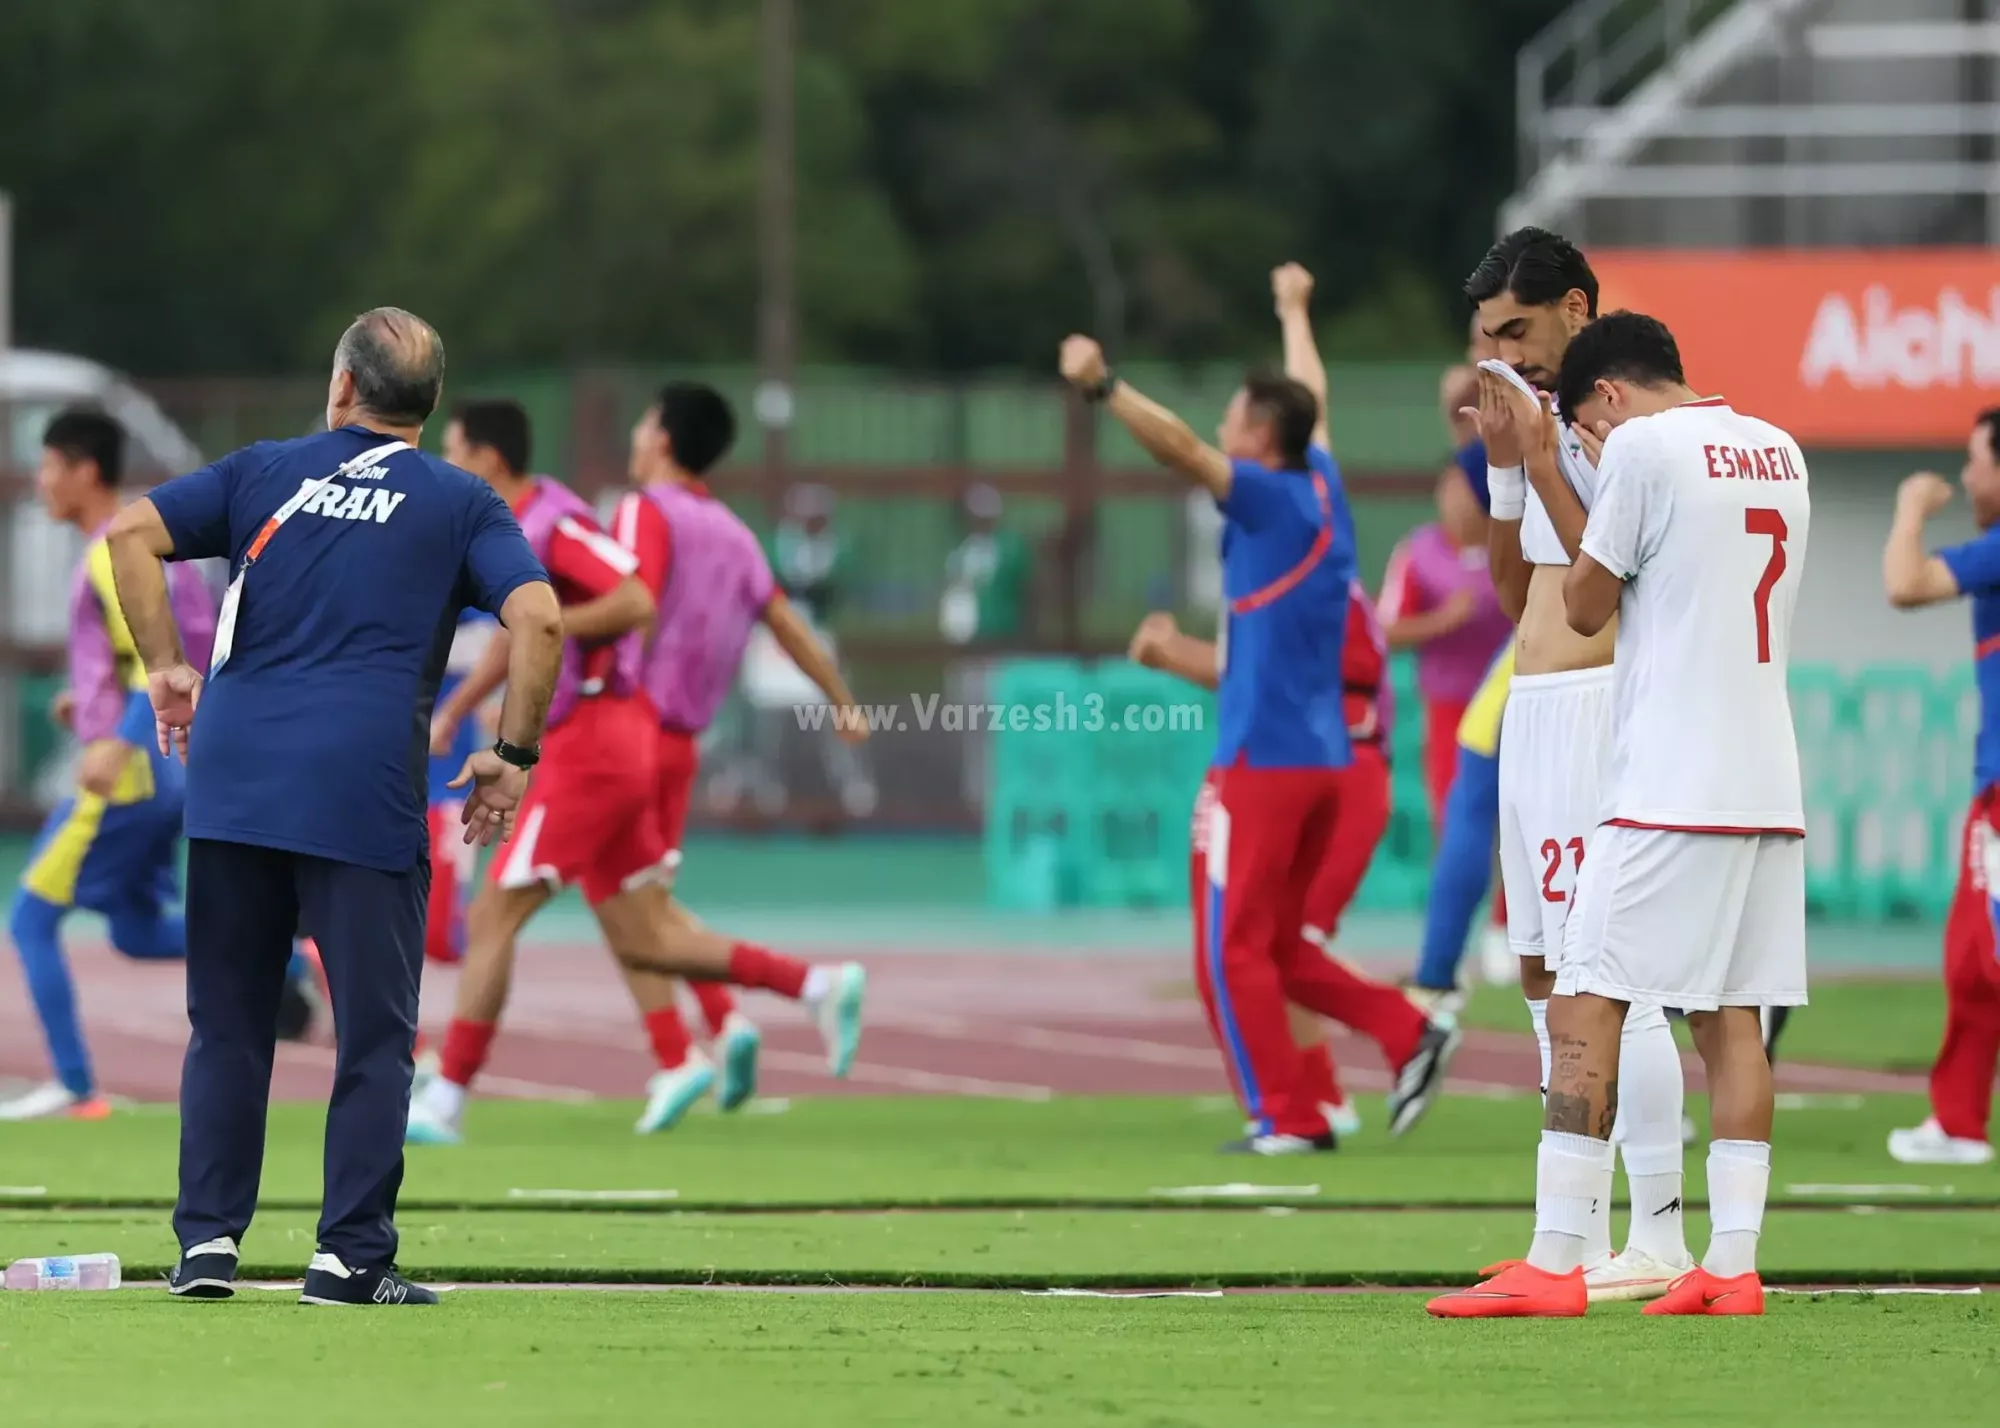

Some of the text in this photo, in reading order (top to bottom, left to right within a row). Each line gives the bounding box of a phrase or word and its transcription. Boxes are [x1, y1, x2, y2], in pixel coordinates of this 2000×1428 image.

[1704, 445, 1799, 480] ESMAEIL
[1745, 508, 1787, 663] 7
[373, 1277, 407, 1305] N
